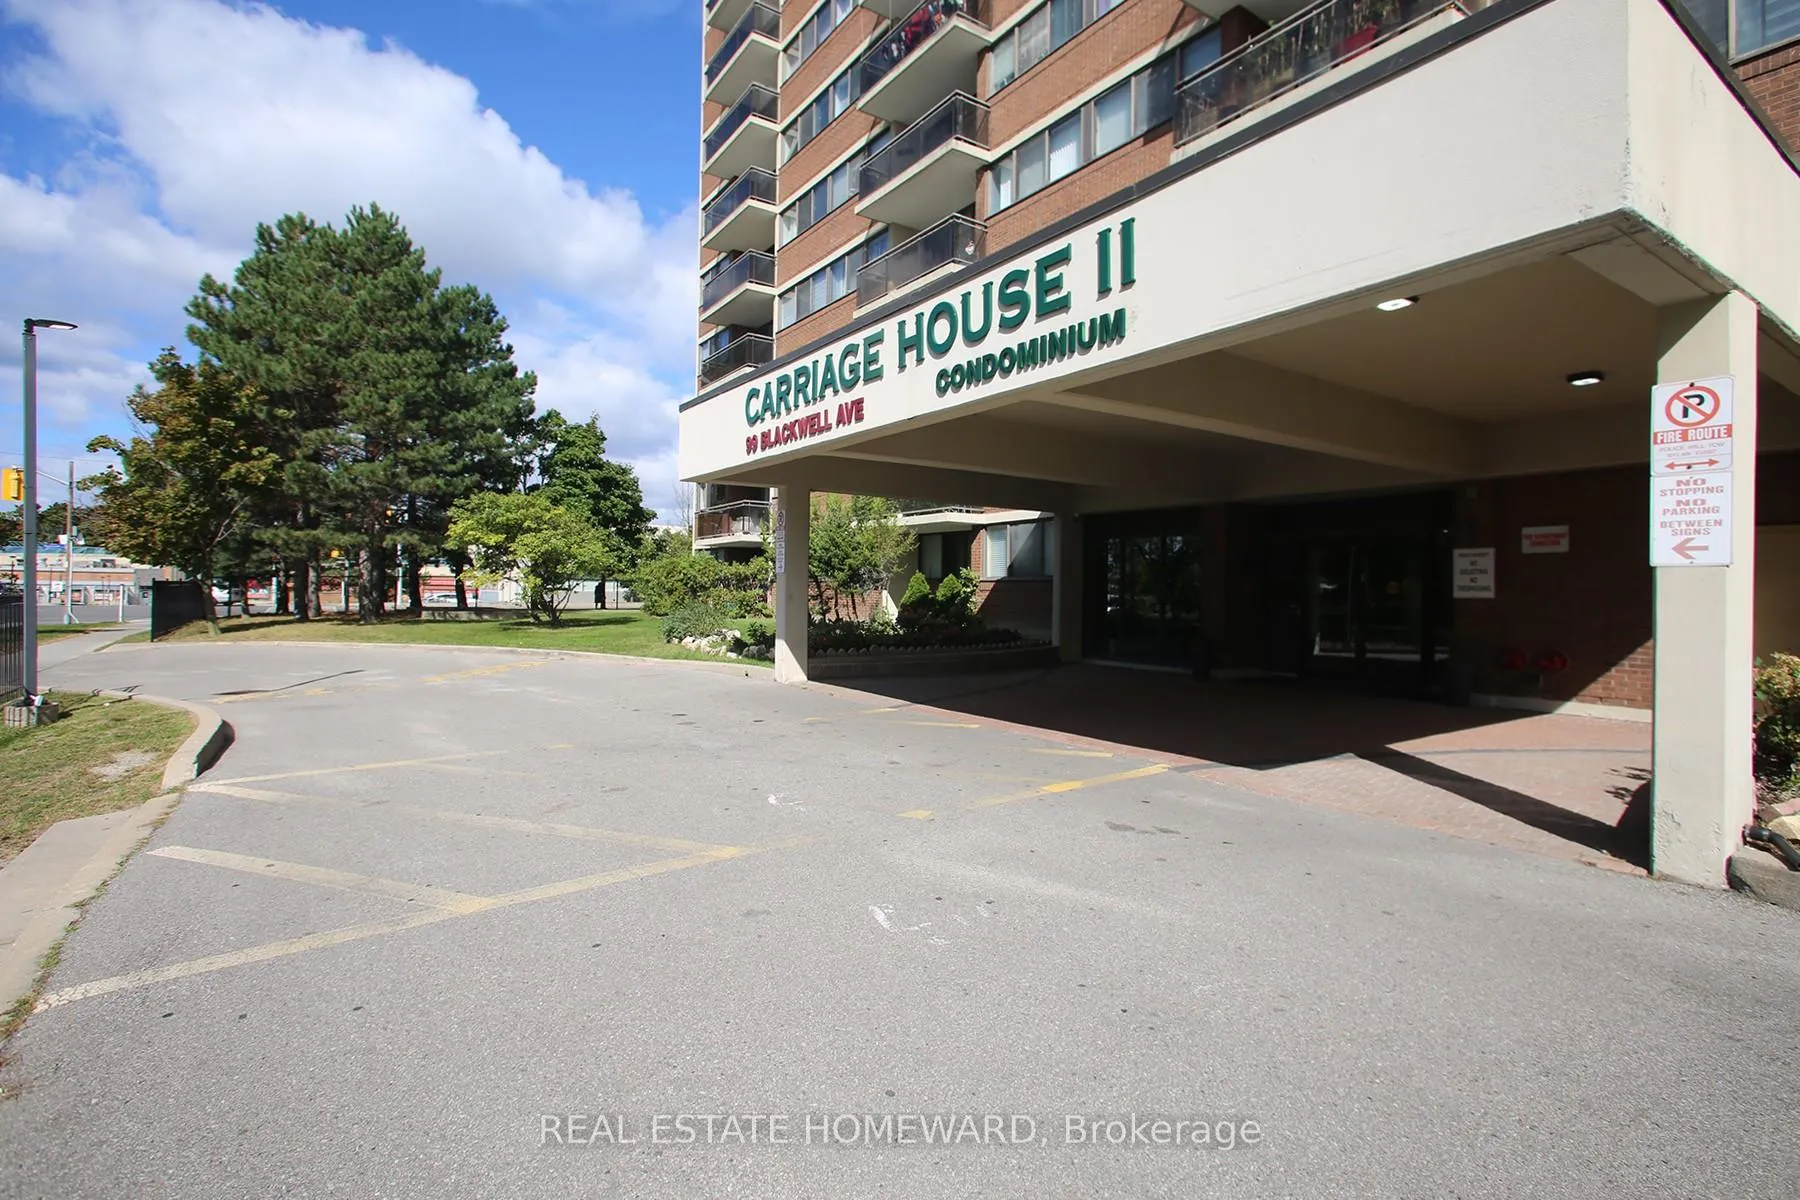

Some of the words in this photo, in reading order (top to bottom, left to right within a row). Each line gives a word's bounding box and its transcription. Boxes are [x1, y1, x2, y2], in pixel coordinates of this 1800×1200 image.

[744, 328, 885, 426] CARRIAGE
[897, 242, 1072, 373] HOUSE
[1096, 216, 1136, 295] II
[935, 307, 1126, 397] CONDOMINIUM
[745, 434, 759, 456] 99
[760, 409, 833, 452] BLACKWELL
[836, 397, 864, 428] AVE
[1657, 430, 1683, 444] FIRE
[1687, 425, 1729, 441] ROUTE
[1675, 478, 1707, 487] NO
[1659, 485, 1725, 497] STOPPING
[1675, 498, 1707, 507] NO
[1662, 506, 1721, 516] PARKING
[1660, 519, 1723, 529] BETWEEN
[1671, 527, 1711, 536] SIGNS
